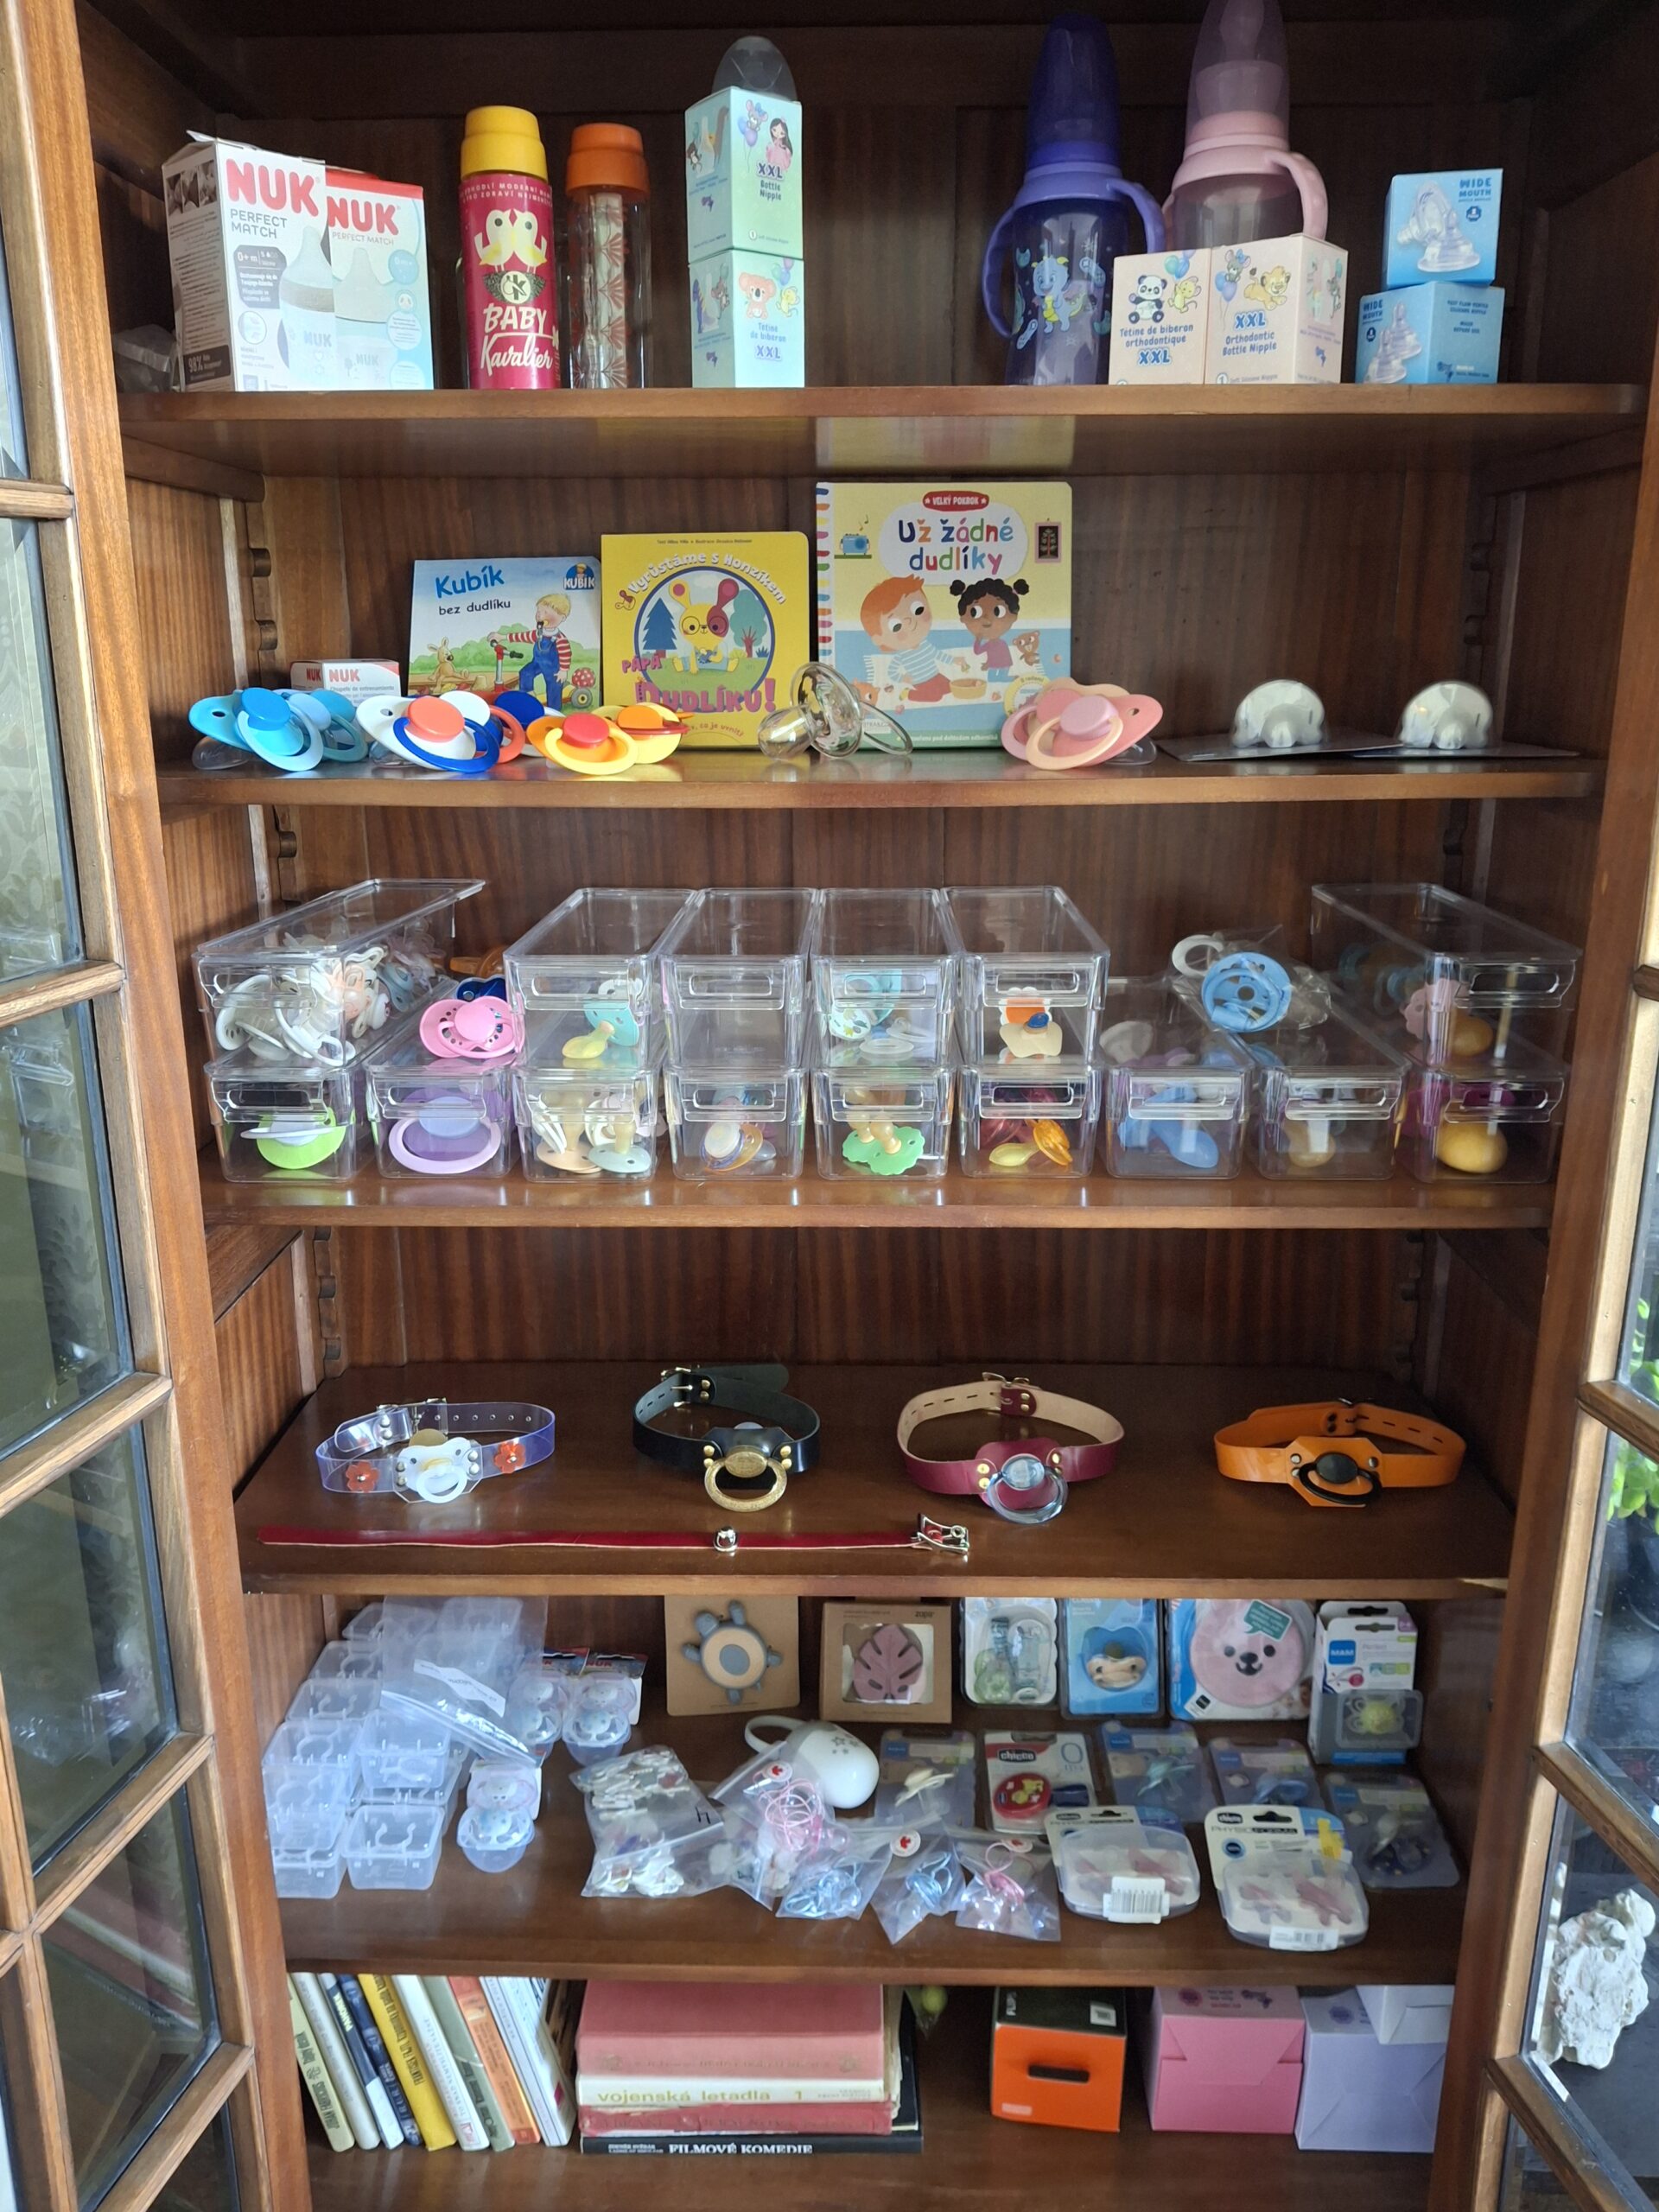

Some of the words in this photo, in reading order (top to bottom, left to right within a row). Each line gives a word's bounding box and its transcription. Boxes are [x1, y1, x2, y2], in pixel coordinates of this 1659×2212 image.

[759, 162, 783, 178] XXL
[226, 158, 319, 217] NUK
[760, 180, 780, 191] Bottle
[1459, 178, 1491, 188] WIDE
[760, 189, 781, 200] Nipple
[230, 208, 288, 228] PERFECT
[327, 196, 398, 235] NUK
[232, 221, 277, 239] MATCH
[333, 232, 365, 242] PERFECT
[367, 237, 394, 245] MATCH
[1363, 300, 1382, 311] WIDE
[483, 302, 547, 335] BABY
[1236, 313, 1265, 328] XXL
[1147, 326, 1157, 334] de
[1160, 324, 1193, 334] biberon
[304, 331, 332, 347] NUK
[761, 333, 786, 342] biberon
[1126, 335, 1186, 347] orthodontique
[1225, 331, 1274, 345] Orthodontic
[480, 333, 553, 377] Kavalier
[757, 346, 780, 359] XXL
[1223, 346, 1246, 356] Bottle
[1249, 342, 1277, 354] Nipple
[356, 354, 378, 365] NUK
[1140, 350, 1170, 364] XXL
[932, 495, 951, 505] VELKÝ
[953, 496, 979, 505] POKROK
[899, 518, 931, 543] Už
[940, 517, 1014, 543] žádné
[909, 545, 1002, 575] dudlíky
[435, 565, 505, 599] Kubík
[628, 553, 706, 594] Vyrůstáme
[712, 553, 719, 564] s
[724, 554, 786, 605] Honzíkem
[439, 606, 461, 615] bez
[467, 599, 511, 613] dudlíku
[622, 654, 663, 674] PÁPÁ
[306, 668, 321, 681] NUK
[328, 669, 360, 683] NUK
[709, 722, 719, 731] je
[1000, 1751, 1034, 1760] chicco
[597, 2090, 690, 2104] vojenská
[702, 2091, 770, 2101] letadla
[795, 2091, 803, 2101] 1
[669, 2143, 736, 2154] FILMOVÉ
[741, 2145, 812, 2154] KOMEDIE
